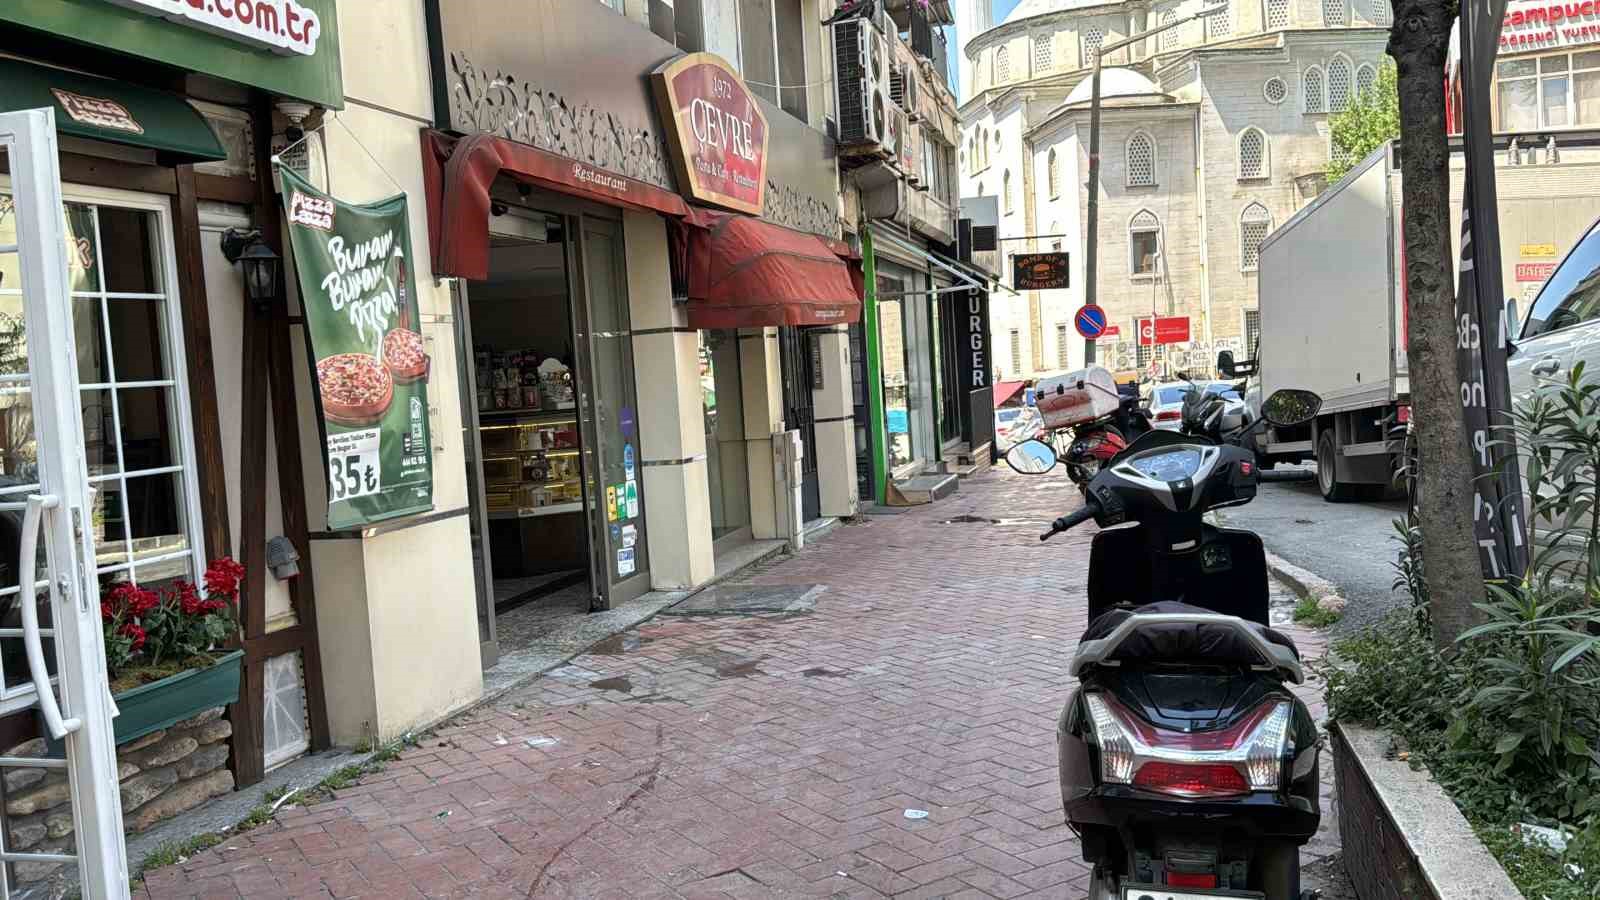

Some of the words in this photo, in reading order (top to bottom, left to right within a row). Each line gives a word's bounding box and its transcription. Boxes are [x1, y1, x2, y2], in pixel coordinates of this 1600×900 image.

[713, 76, 732, 98] 1972
[690, 98, 753, 161] ÇEVRE
[572, 163, 627, 192] Restaurant
[328, 229, 393, 275] Buram
[321, 261, 385, 311] Buram
